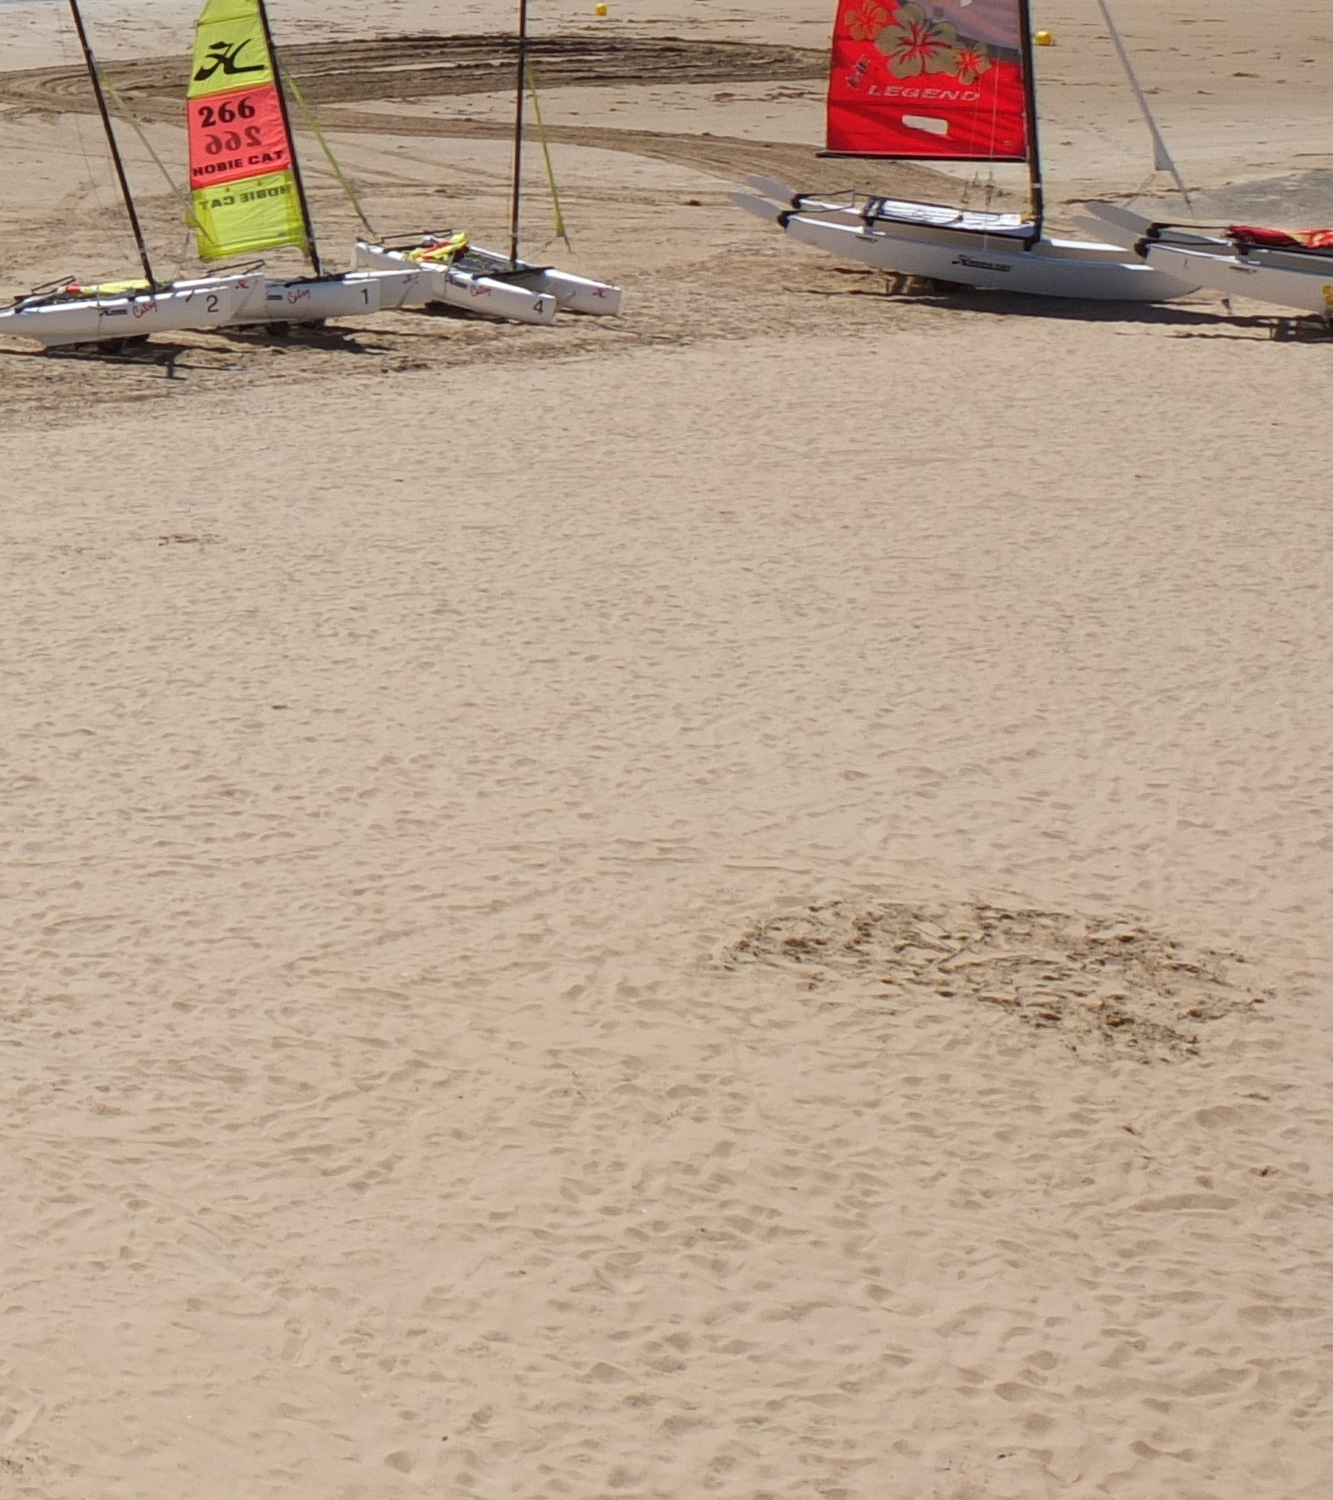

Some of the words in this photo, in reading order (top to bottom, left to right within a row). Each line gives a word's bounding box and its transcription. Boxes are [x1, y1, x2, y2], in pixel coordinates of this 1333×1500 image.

[868, 85, 981, 101] LEGEND
[198, 96, 256, 129] 266
[193, 159, 243, 176] HOBIE
[248, 150, 283, 165] CAT
[206, 294, 219, 313] 2
[360, 288, 369, 305] 1
[533, 299, 544, 315] 4
